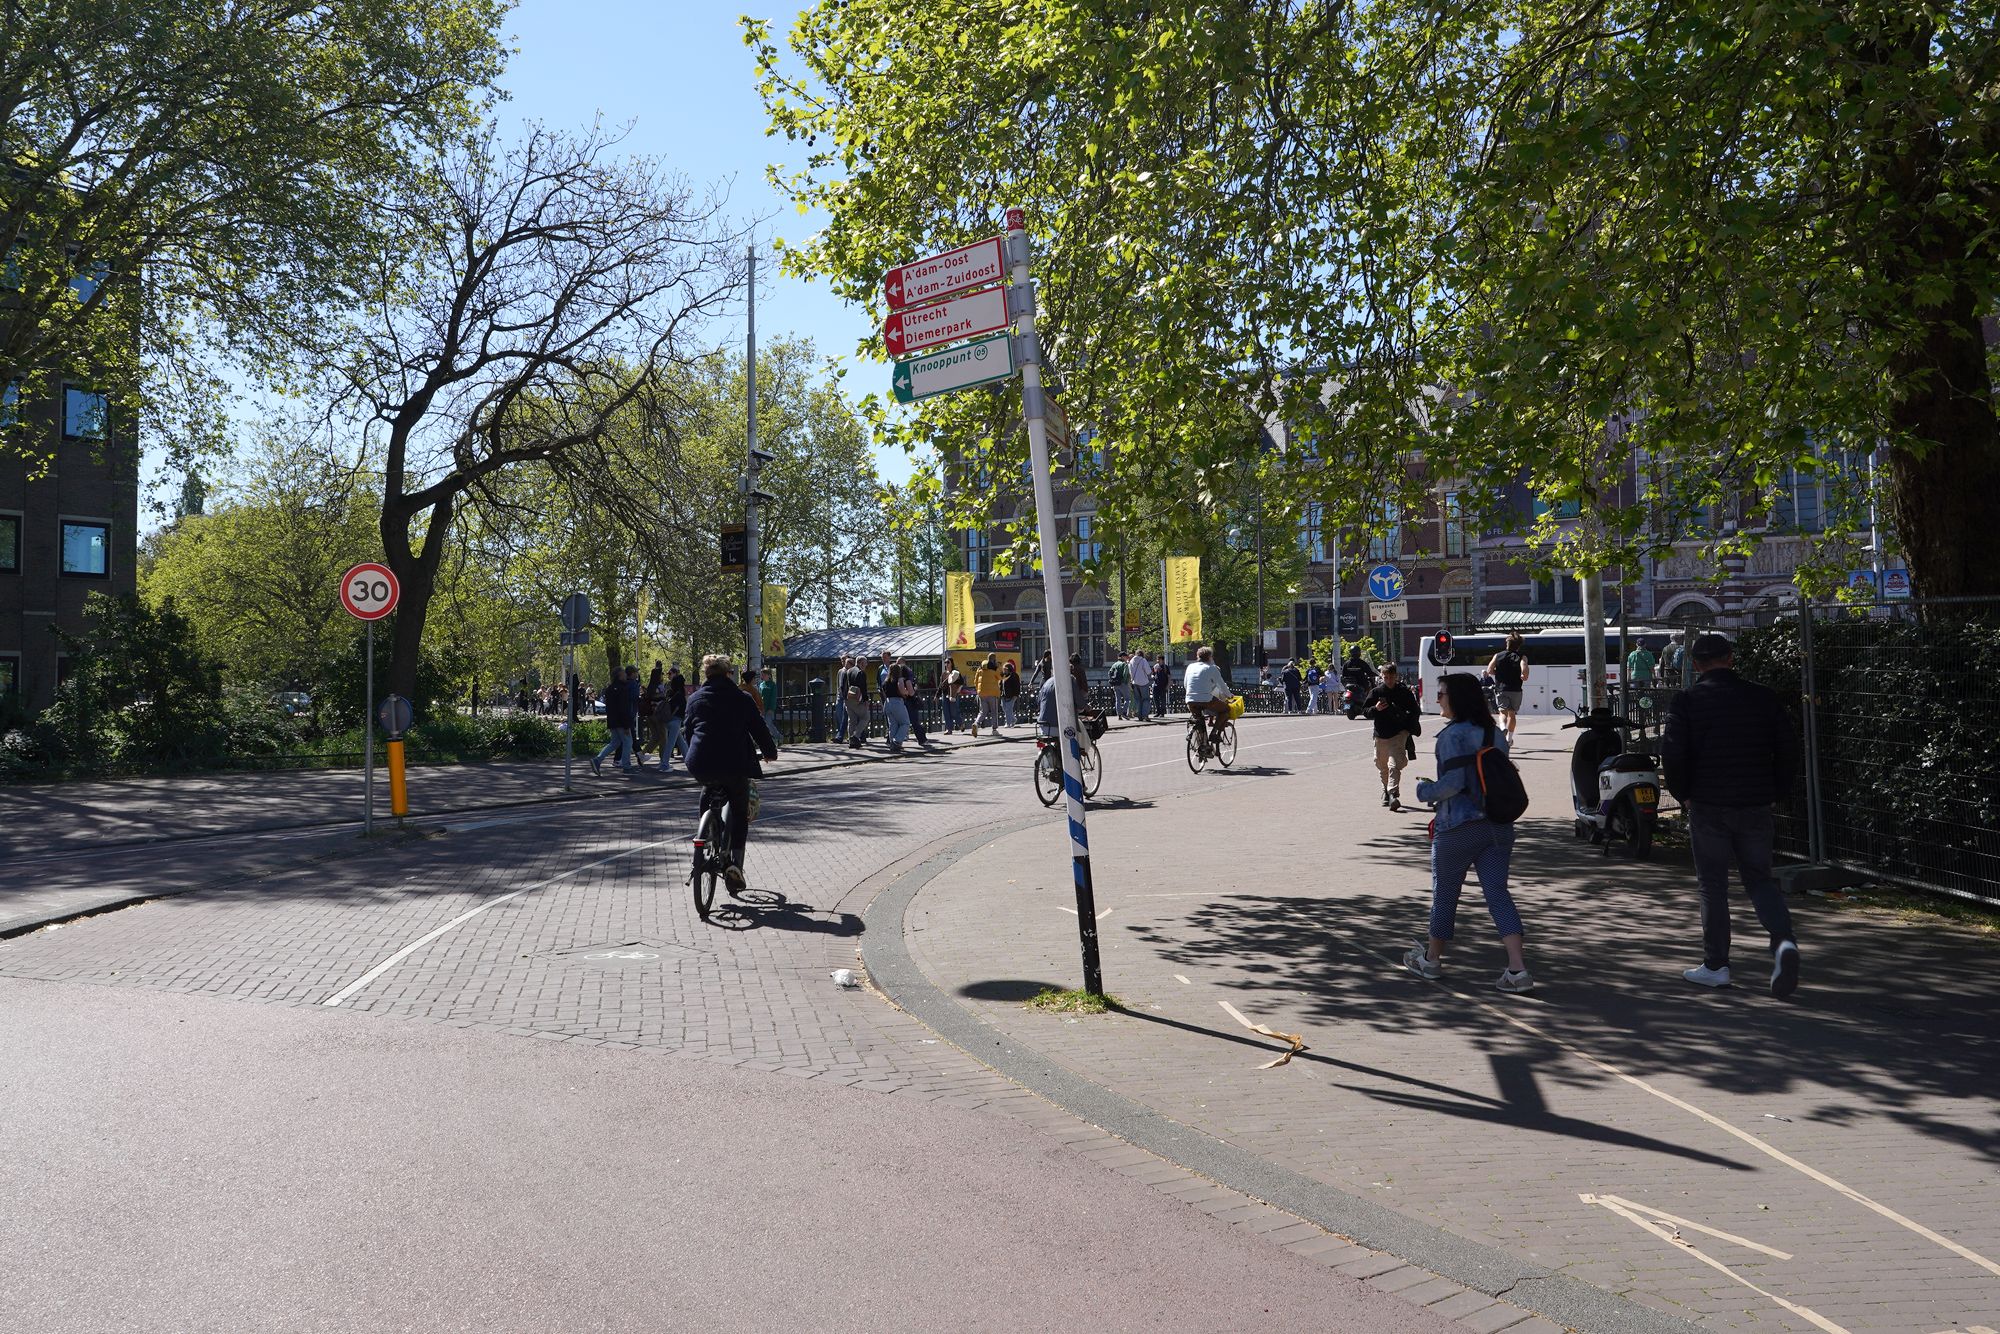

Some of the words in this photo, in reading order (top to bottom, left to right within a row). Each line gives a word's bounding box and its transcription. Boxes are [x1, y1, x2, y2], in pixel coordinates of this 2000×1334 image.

[904, 253, 969, 282] A'dam-Oost
[906, 263, 996, 299] A'dam-Zuidoost
[904, 306, 948, 327] Utrecht
[906, 318, 972, 345] Diemerpark
[912, 350, 972, 375] Knooppunt
[352, 580, 389, 602] 30
